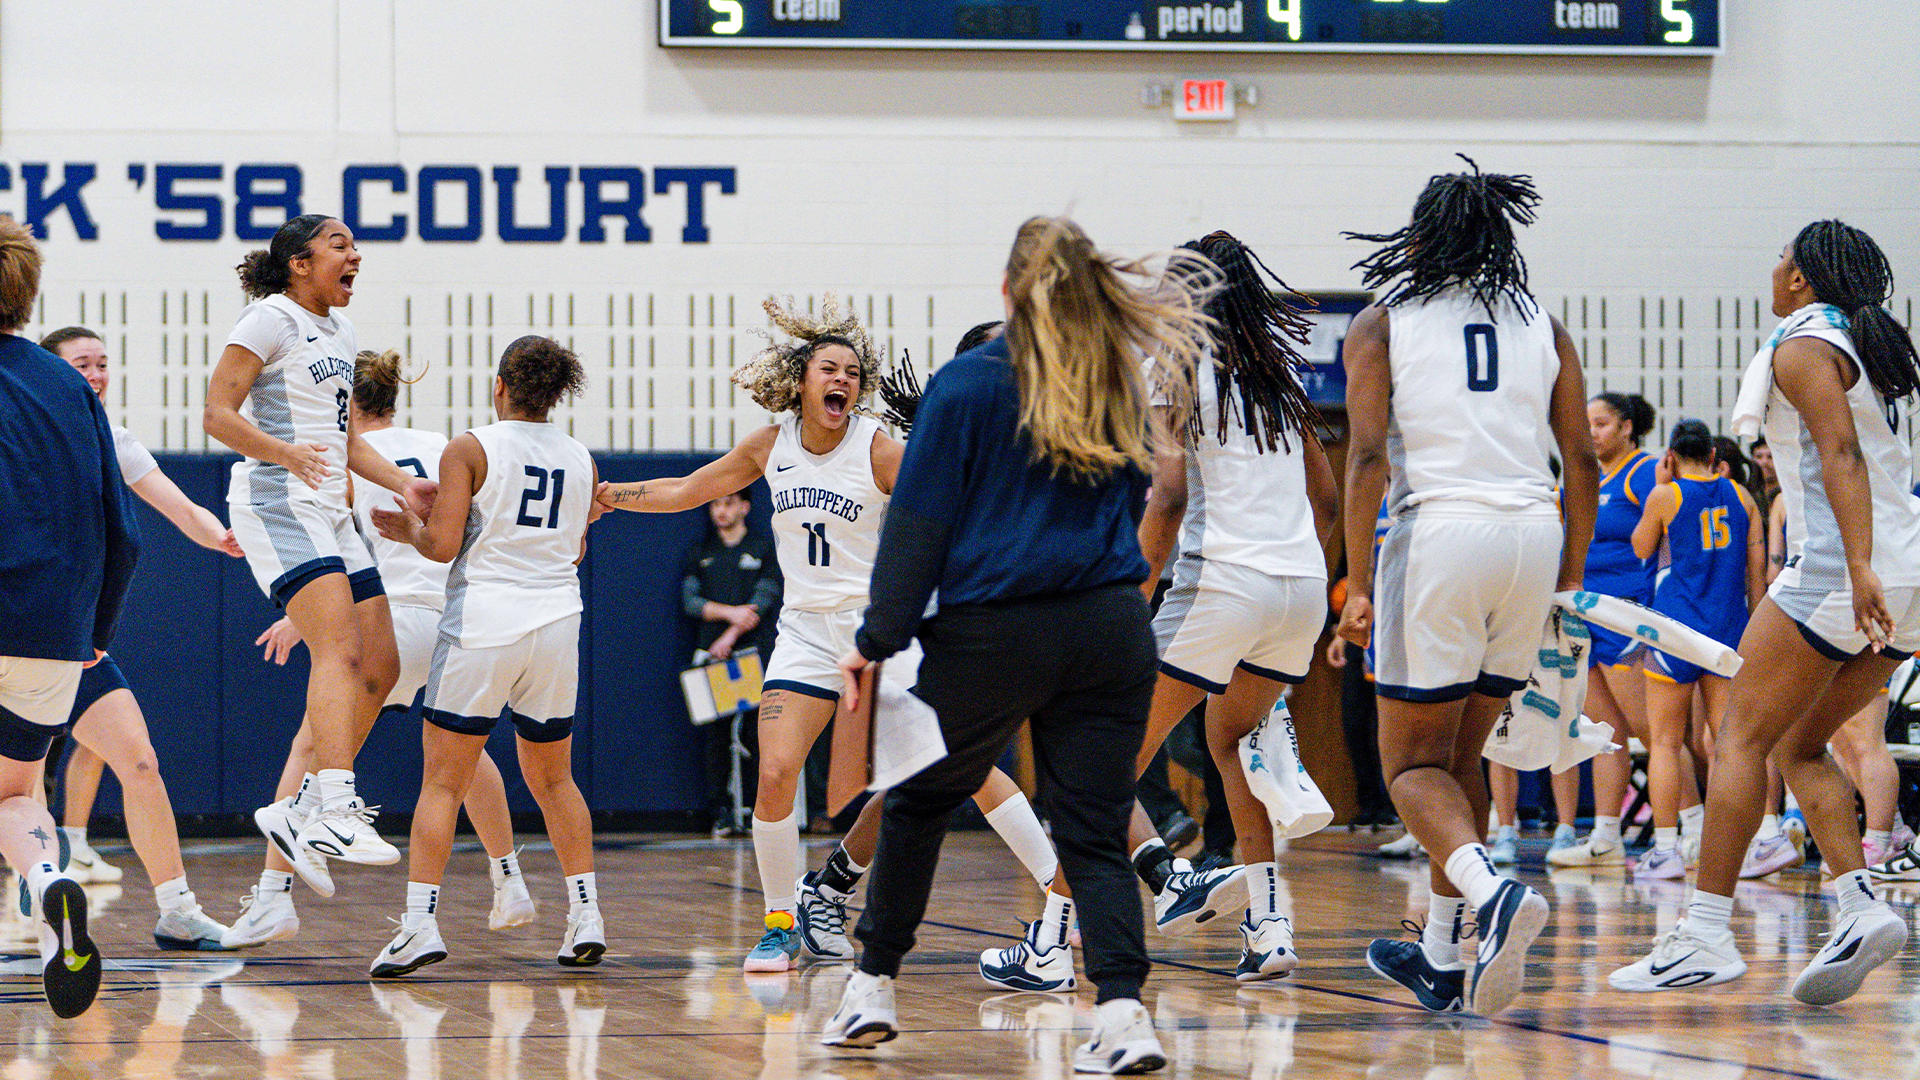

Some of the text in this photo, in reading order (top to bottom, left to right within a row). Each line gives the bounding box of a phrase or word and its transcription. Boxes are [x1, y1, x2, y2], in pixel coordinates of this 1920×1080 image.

[773, 0, 840, 21] team
[1158, 0, 1243, 39] period
[1555, 0, 1619, 29] team
[1661, 0, 1693, 43] 5
[1183, 80, 1227, 112] EXIT
[0, 164, 738, 243] K '58 COURT
[1463, 324, 1499, 392] 0
[516, 465, 565, 529] 21
[775, 487, 863, 523] HILLTOPPERS
[801, 522, 830, 567] 11
[1699, 505, 1732, 551] 15
